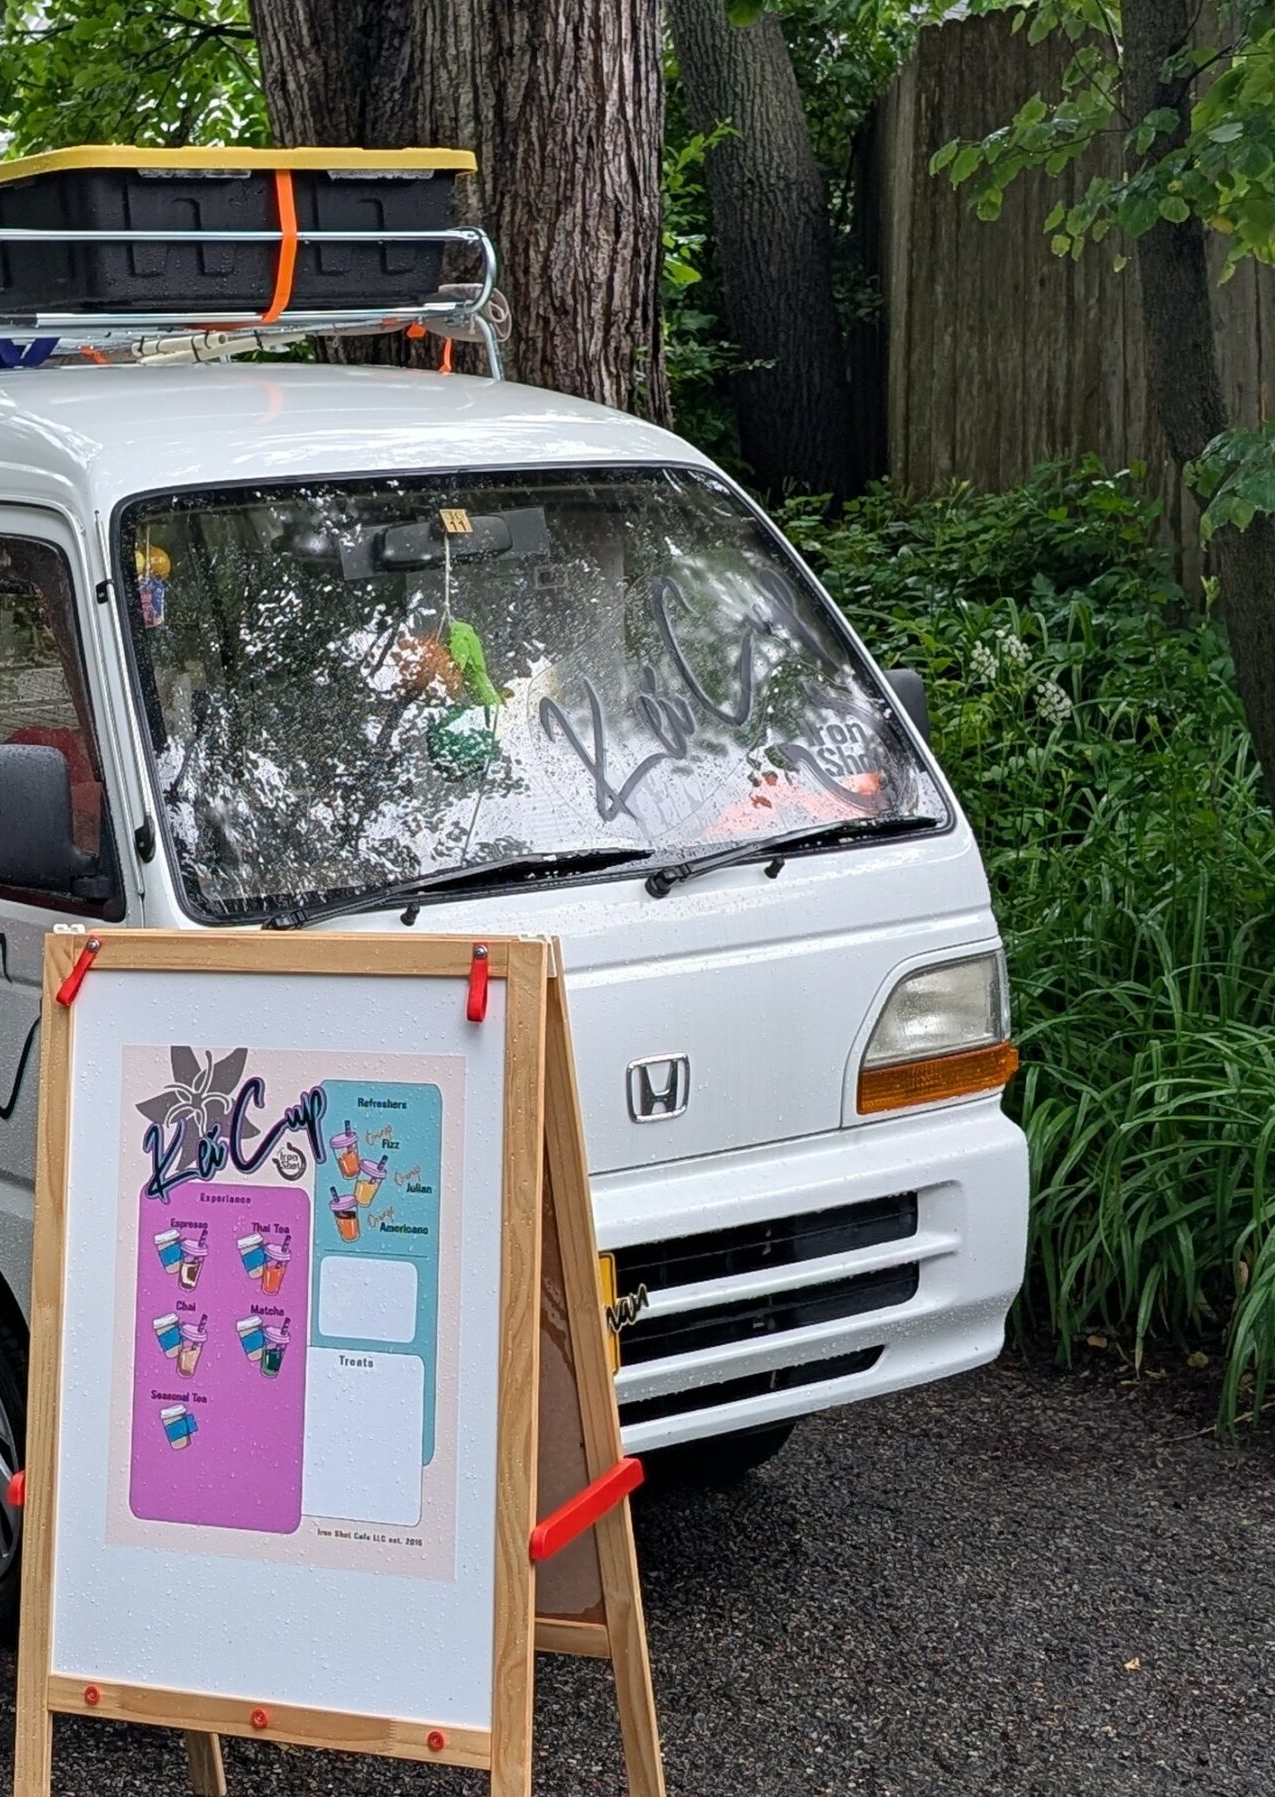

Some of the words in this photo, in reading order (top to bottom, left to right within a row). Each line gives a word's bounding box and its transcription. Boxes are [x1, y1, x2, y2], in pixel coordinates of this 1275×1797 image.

[450, 520, 467, 531] 11
[797, 717, 868, 747] Iron
[818, 745, 880, 777] Sho
[357, 1097, 408, 1109] Refreshers
[382, 1139, 400, 1150] Fizz
[279, 1151, 298, 1161] Iron
[406, 1182, 433, 1195] Julian
[199, 1192, 252, 1204] Experience
[170, 1217, 209, 1230] Espresso
[251, 1222, 270, 1233] Thai
[274, 1223, 290, 1234] Tea
[380, 1222, 429, 1235] Americano
[176, 1301, 196, 1312] Chai
[250, 1304, 285, 1317] Matcha
[338, 1354, 375, 1368] Treats
[150, 1390, 190, 1403] Seasonal
[192, 1392, 207, 1404] Tea
[316, 1527, 332, 1537] Iron
[334, 1529, 351, 1539] Shot
[372, 1533, 386, 1543] LLC
